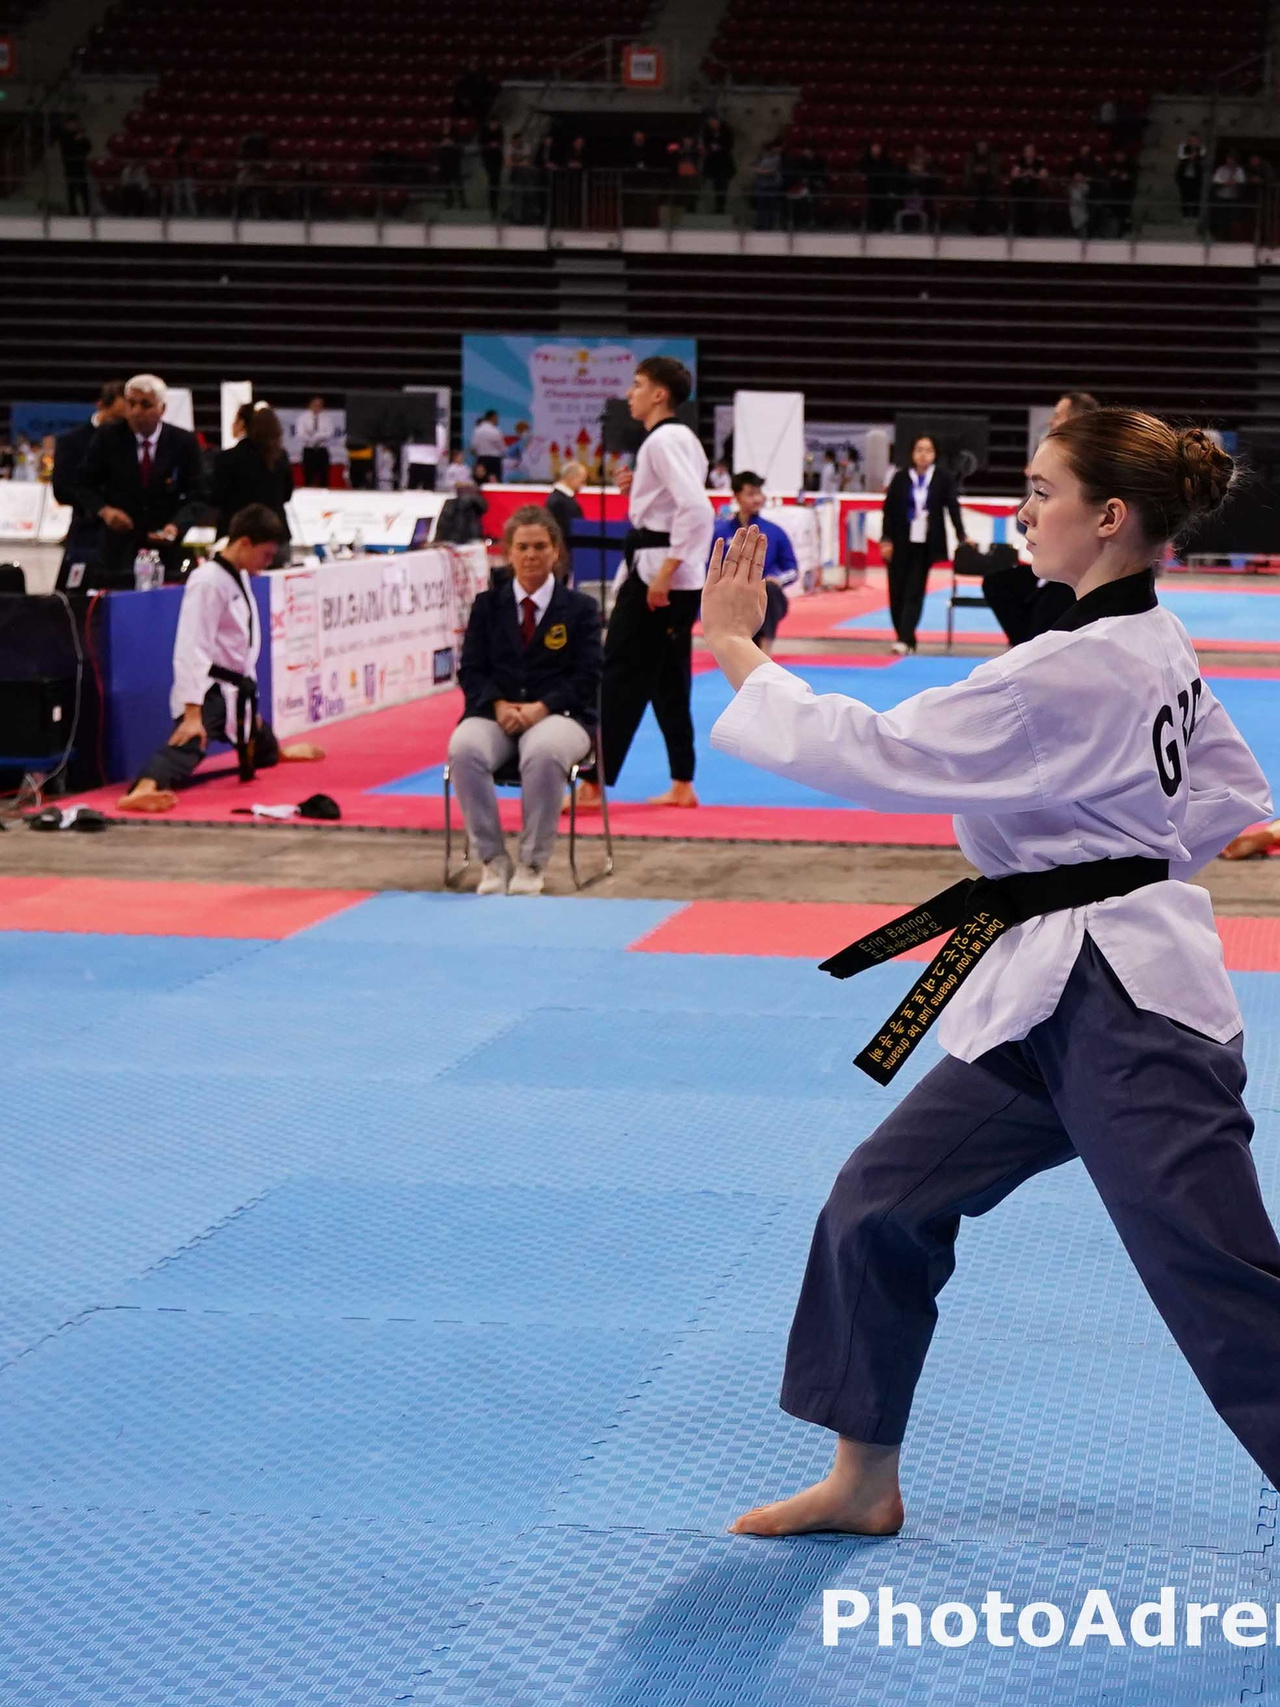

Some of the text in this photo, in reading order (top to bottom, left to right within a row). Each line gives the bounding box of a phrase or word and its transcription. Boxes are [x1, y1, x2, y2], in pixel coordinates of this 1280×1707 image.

[858, 937, 886, 952] Erin
[885, 911, 932, 939] Bannon
[882, 918, 1005, 1070] Don't let your dreams just be dreams
